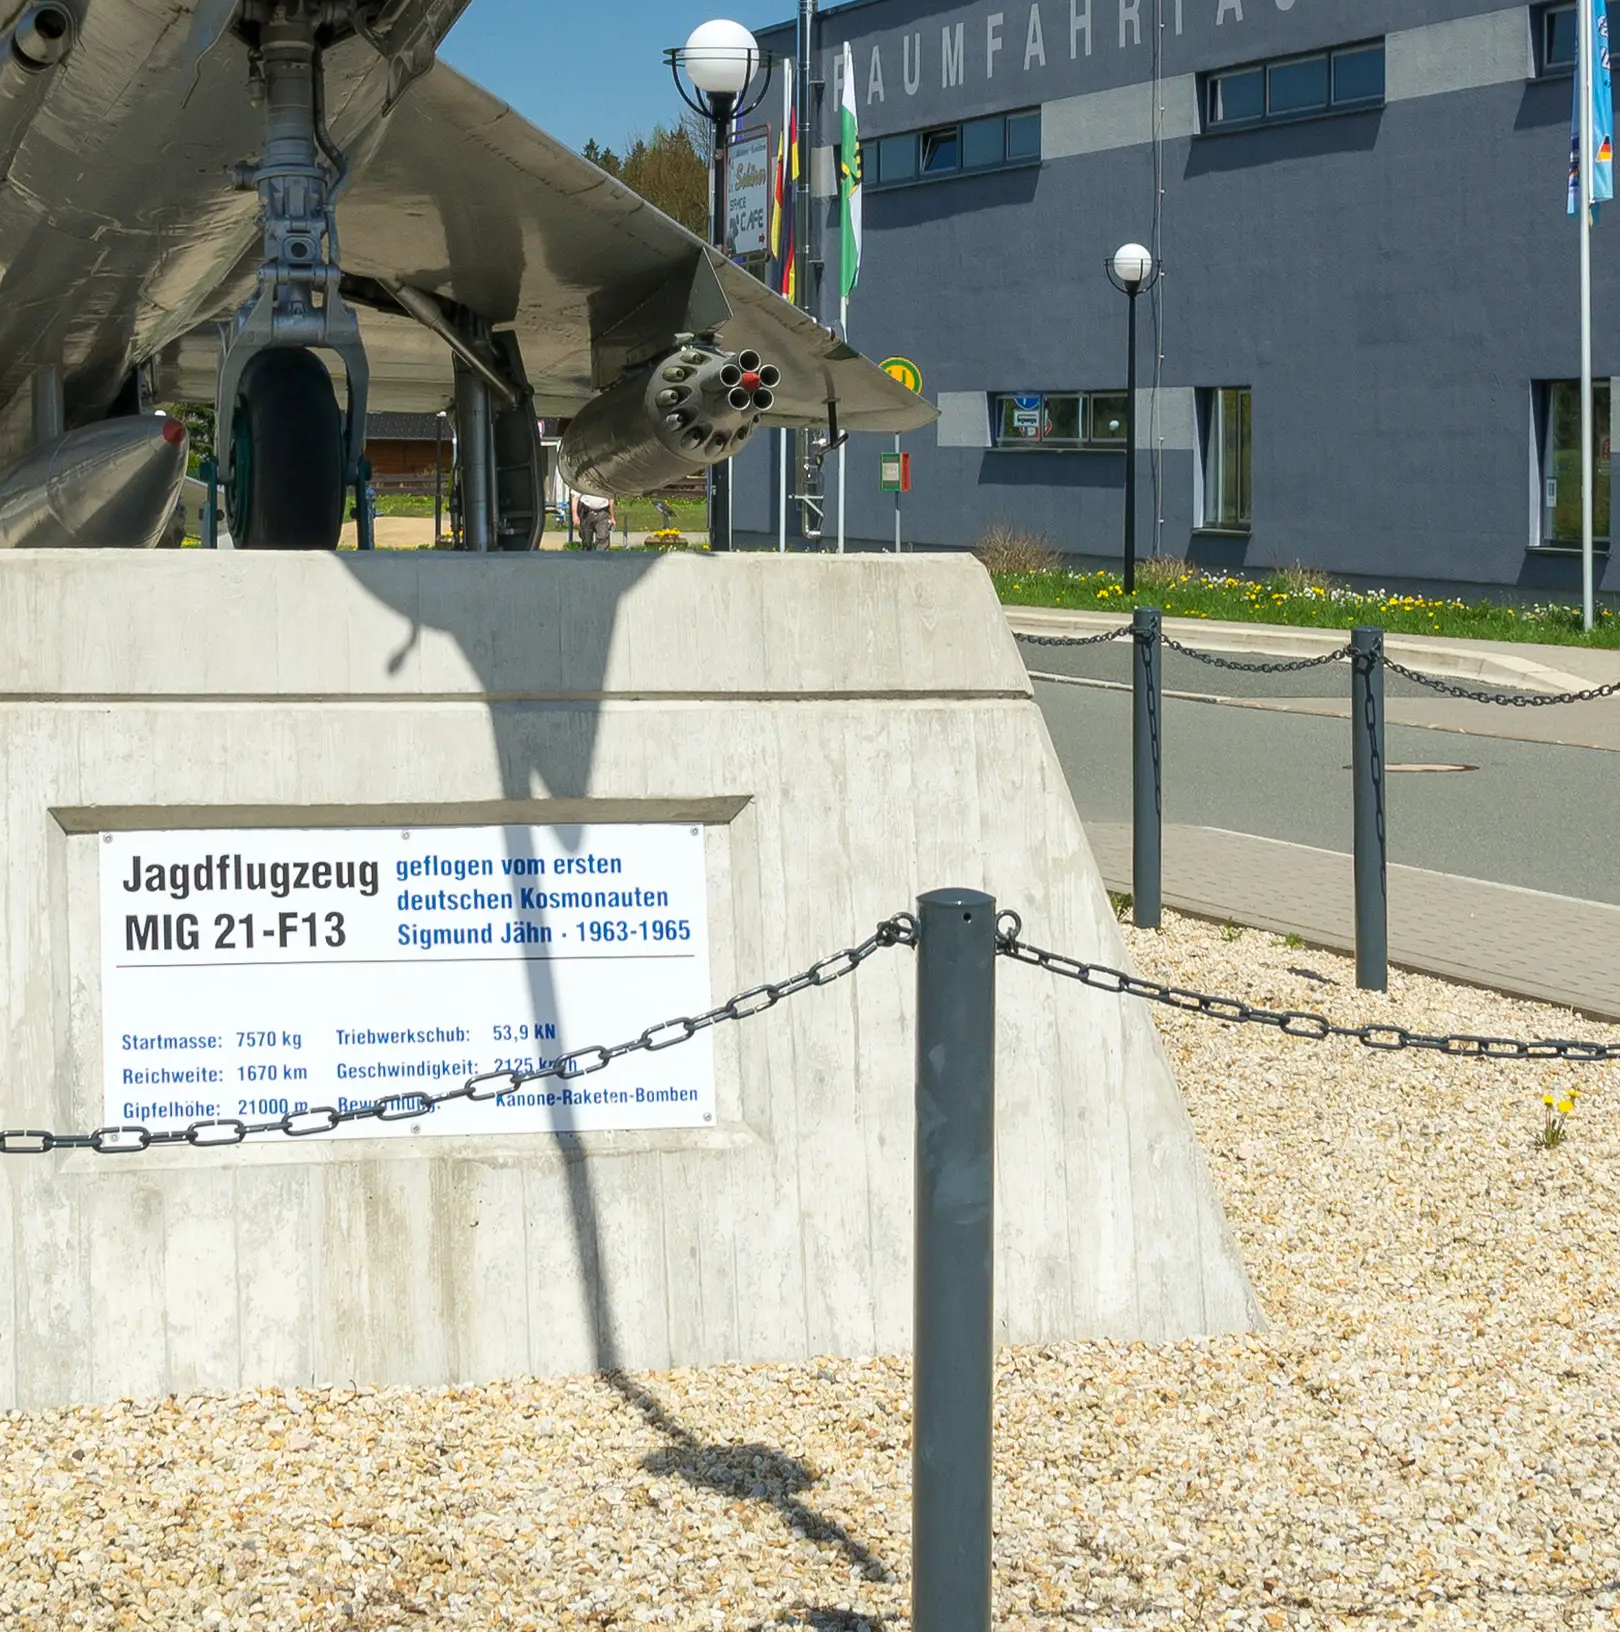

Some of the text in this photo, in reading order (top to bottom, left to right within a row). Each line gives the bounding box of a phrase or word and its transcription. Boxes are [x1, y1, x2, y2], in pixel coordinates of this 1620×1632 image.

[123, 854, 378, 899] Jagdflugzeug
[396, 854, 622, 880] geflogen vom ersten
[397, 887, 669, 911] deutschen Kosmonauten
[126, 912, 346, 950] MIG 21-F13
[398, 922, 492, 949] Sigmund
[501, 921, 552, 943] Jähn
[576, 920, 691, 942] 1963-1965
[122, 1030, 302, 1051] Startmasse: 7570 kg
[336, 1023, 556, 1044] Triebwerkschub: 53,9 KN
[123, 1064, 308, 1084] Reichweite: 1670 km
[337, 1060, 478, 1079] Geschwindigkeit:
[494, 1058, 533, 1074] 2125
[496, 1088, 697, 1107] Kanone-Raketen-Bomben
[124, 1099, 308, 1120] Gipfelhöhe: 21000 m
